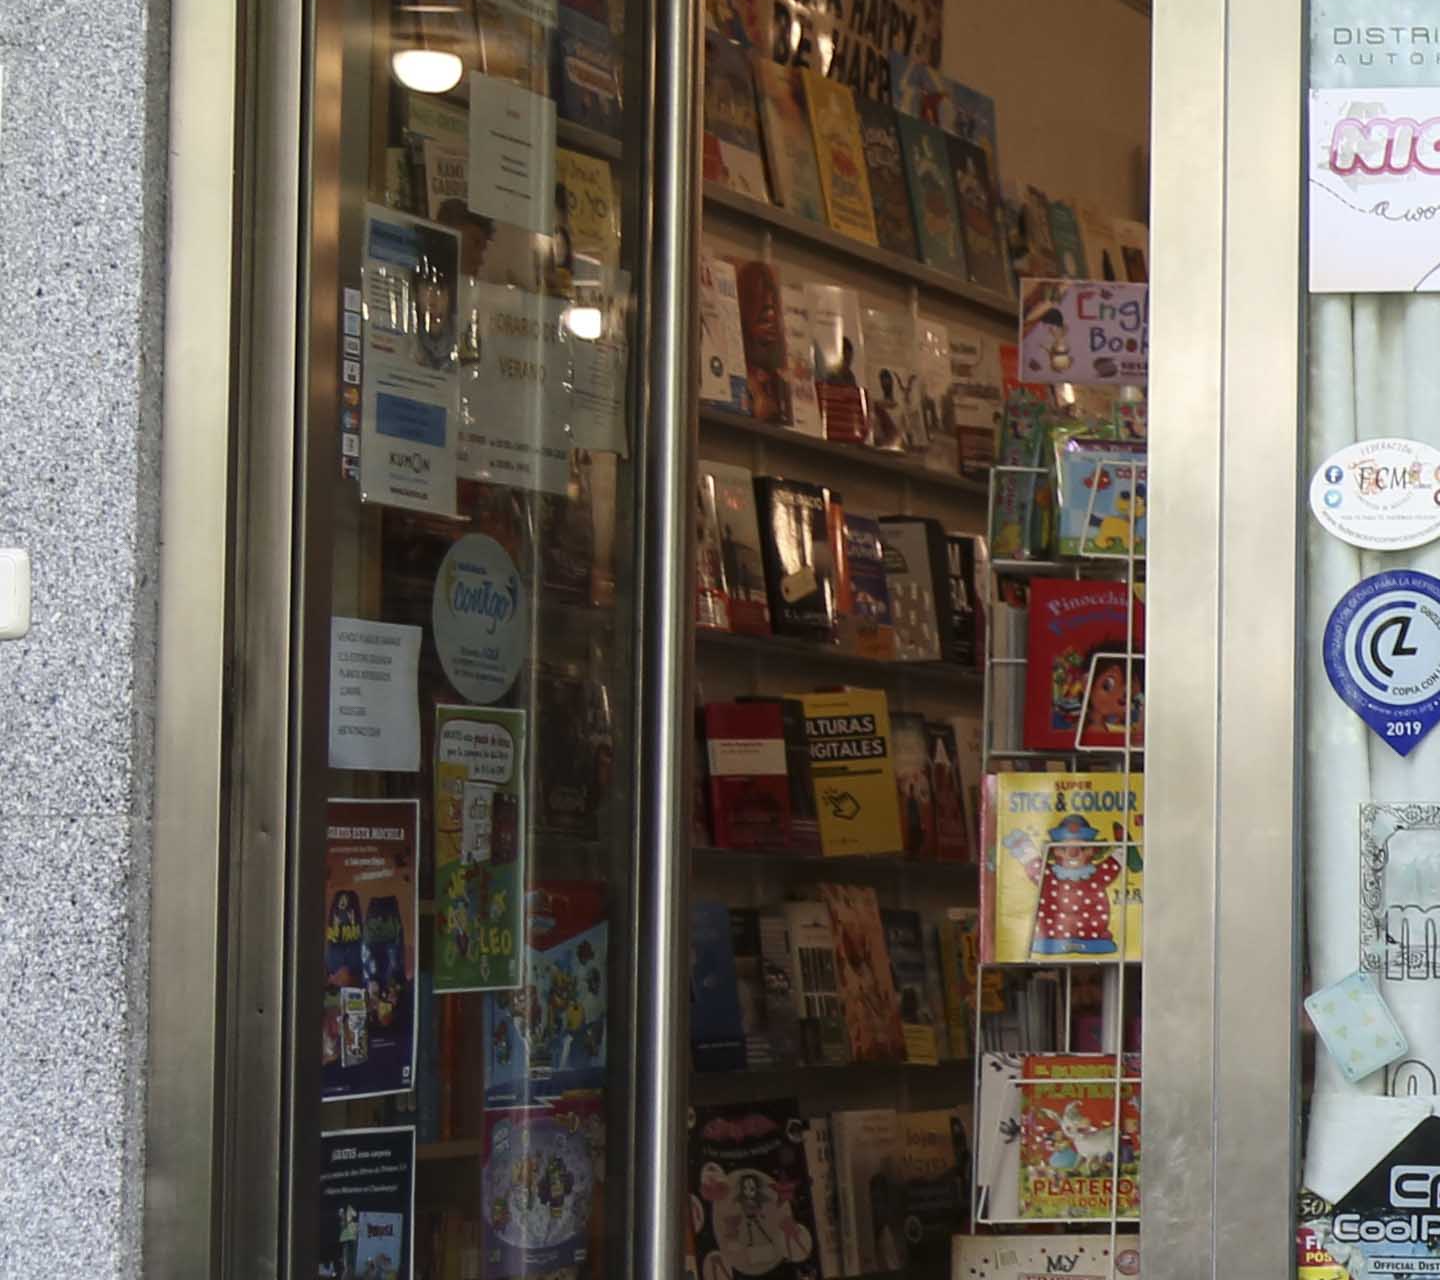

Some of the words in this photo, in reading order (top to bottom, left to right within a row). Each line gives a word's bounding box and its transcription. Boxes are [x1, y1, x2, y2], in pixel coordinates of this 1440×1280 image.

[1386, 721, 1422, 736] 2019
[1070, 790, 1137, 812] COLOUR
[479, 926, 514, 958] LEO
[1034, 1178, 1135, 1196] PLATERO
[1046, 1254, 1081, 1273] MY
[1373, 1259, 1415, 1271] OFFICIAL
